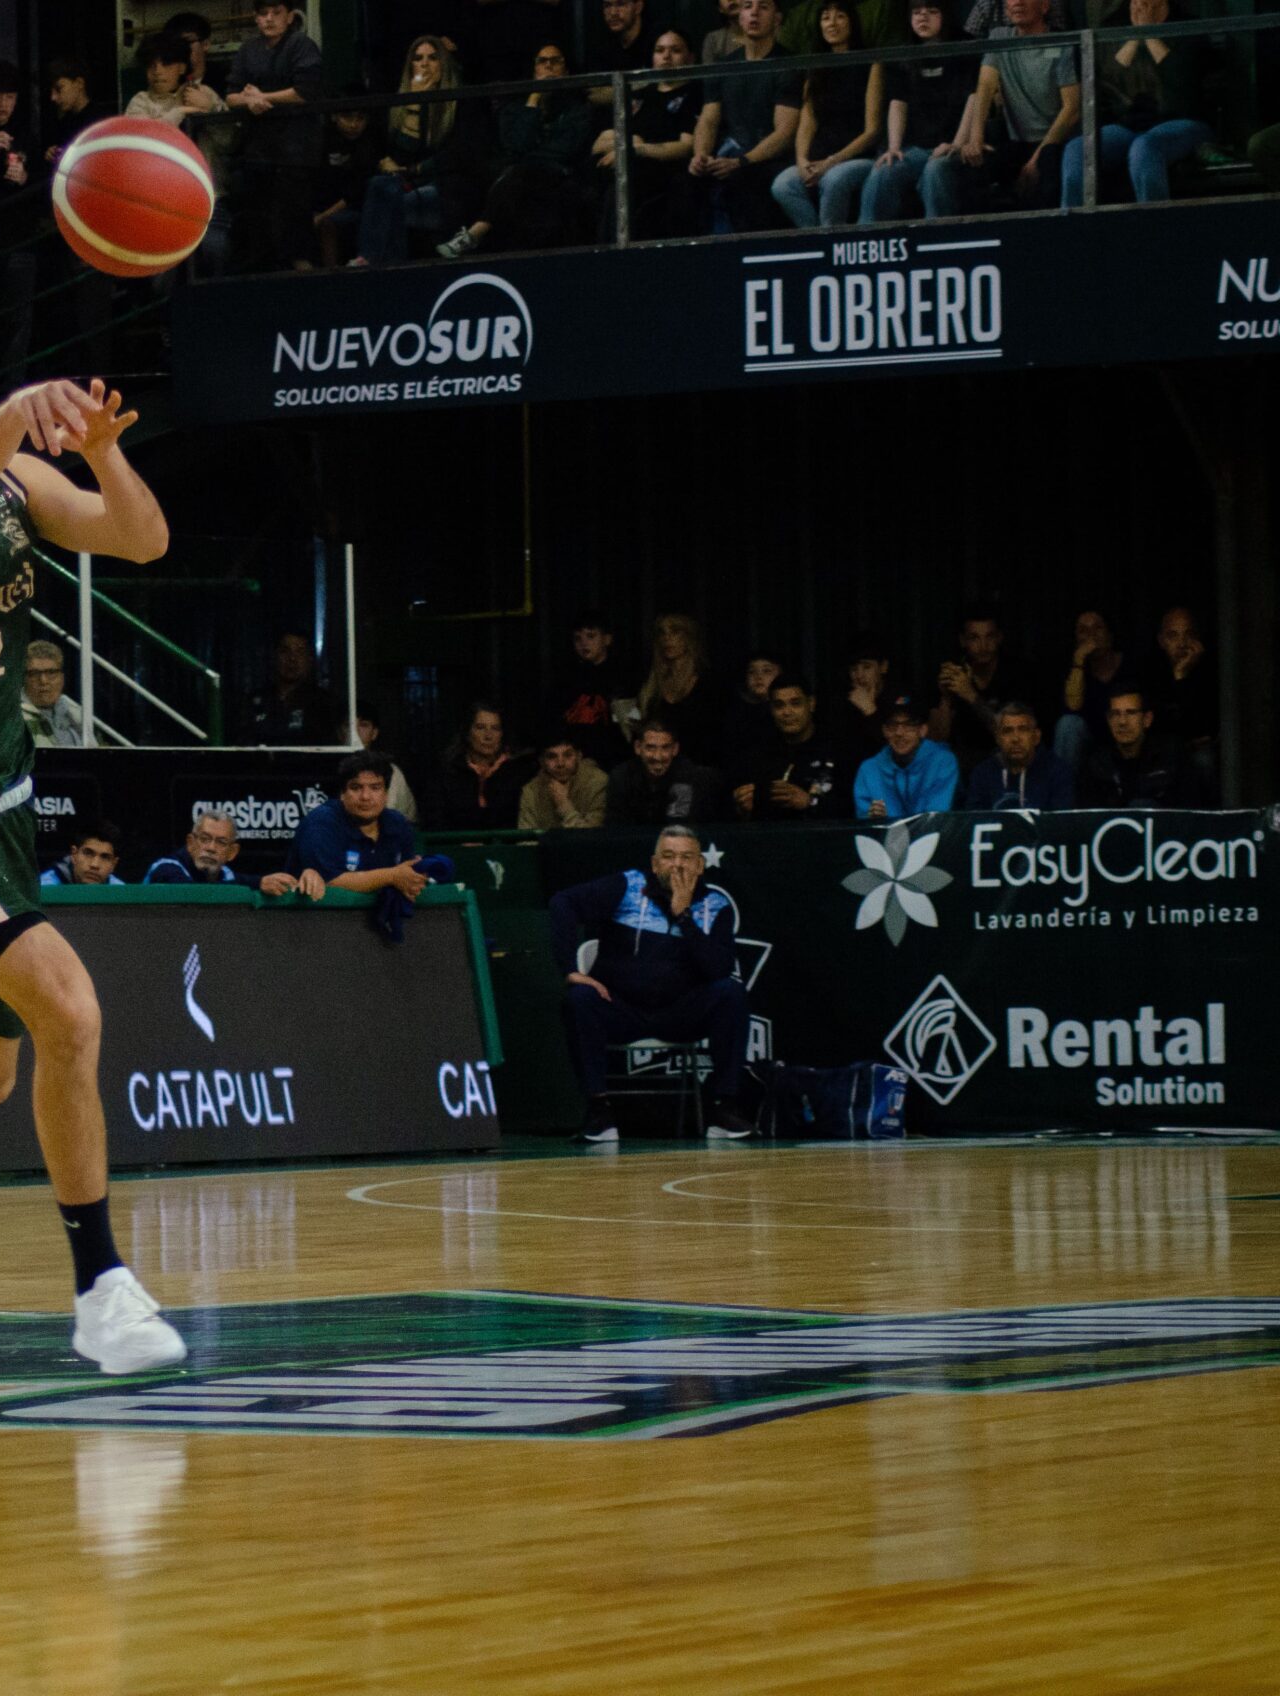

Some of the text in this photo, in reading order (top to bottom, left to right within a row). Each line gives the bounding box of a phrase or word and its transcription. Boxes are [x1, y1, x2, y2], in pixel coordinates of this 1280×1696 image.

[832, 238, 909, 266] MUEBLES
[745, 264, 1002, 357] EL OBRERO
[274, 373, 522, 407] SOLUCIONES ELÉCTRICAS
[969, 817, 1258, 907] EasyClean
[974, 903, 1260, 930] Lavandería y Limpieza
[1006, 1002, 1226, 1069] Rental
[128, 1068, 295, 1131] CATAPULT
[1096, 1076, 1226, 1106] Solution
